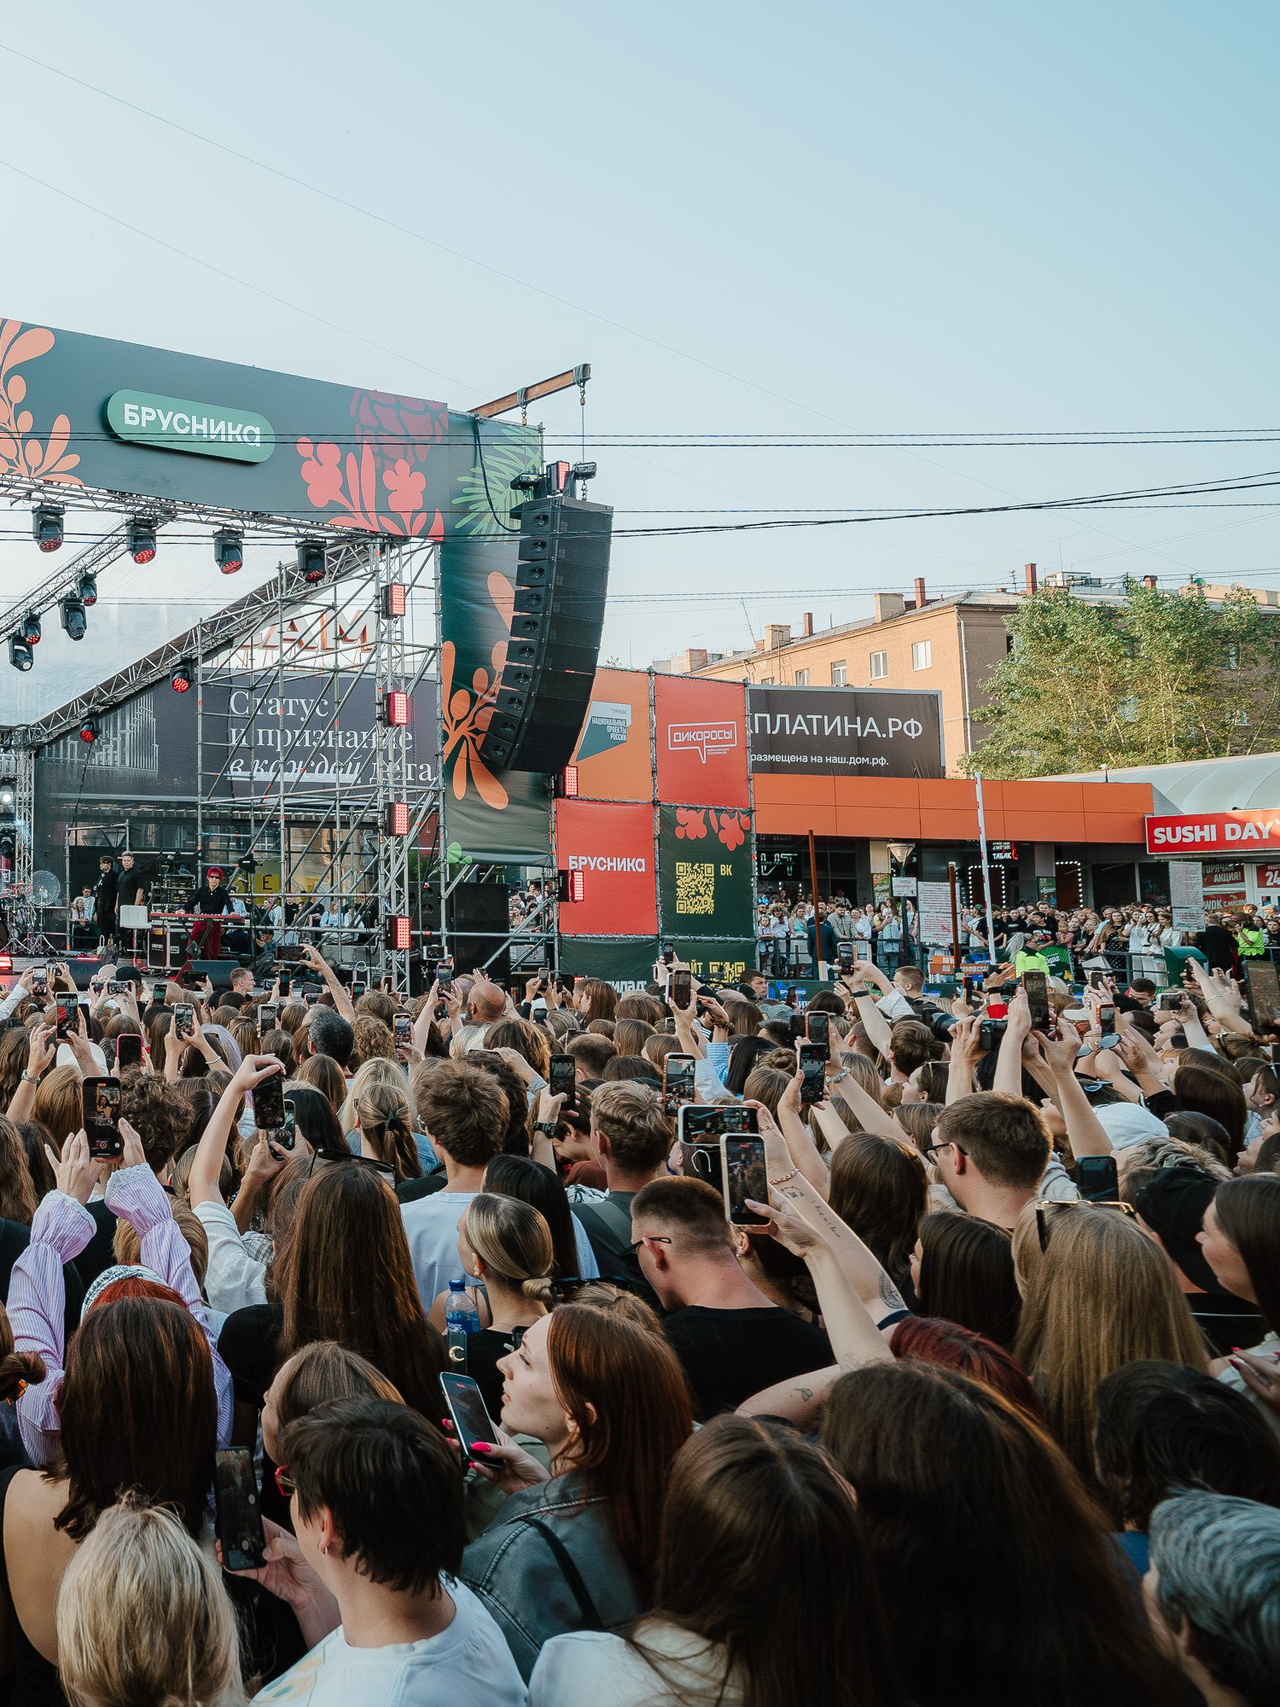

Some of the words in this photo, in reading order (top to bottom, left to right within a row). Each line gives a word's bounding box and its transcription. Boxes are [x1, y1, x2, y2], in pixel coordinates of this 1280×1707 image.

[229, 690, 329, 721] Статус
[748, 713, 924, 739] ПЛАТИНА.РФ
[673, 729, 733, 743] ДИКОРОСЫ
[751, 752, 808, 764] размещена
[810, 755, 823, 763] на
[825, 755, 889, 767] наш.дом.рф.
[369, 762, 439, 783] дета
[1153, 824, 1217, 844] SUSHI
[1224, 821, 1274, 841] DAY
[720, 864, 733, 876] ВК
[685, 959, 704, 974] АЙТ
